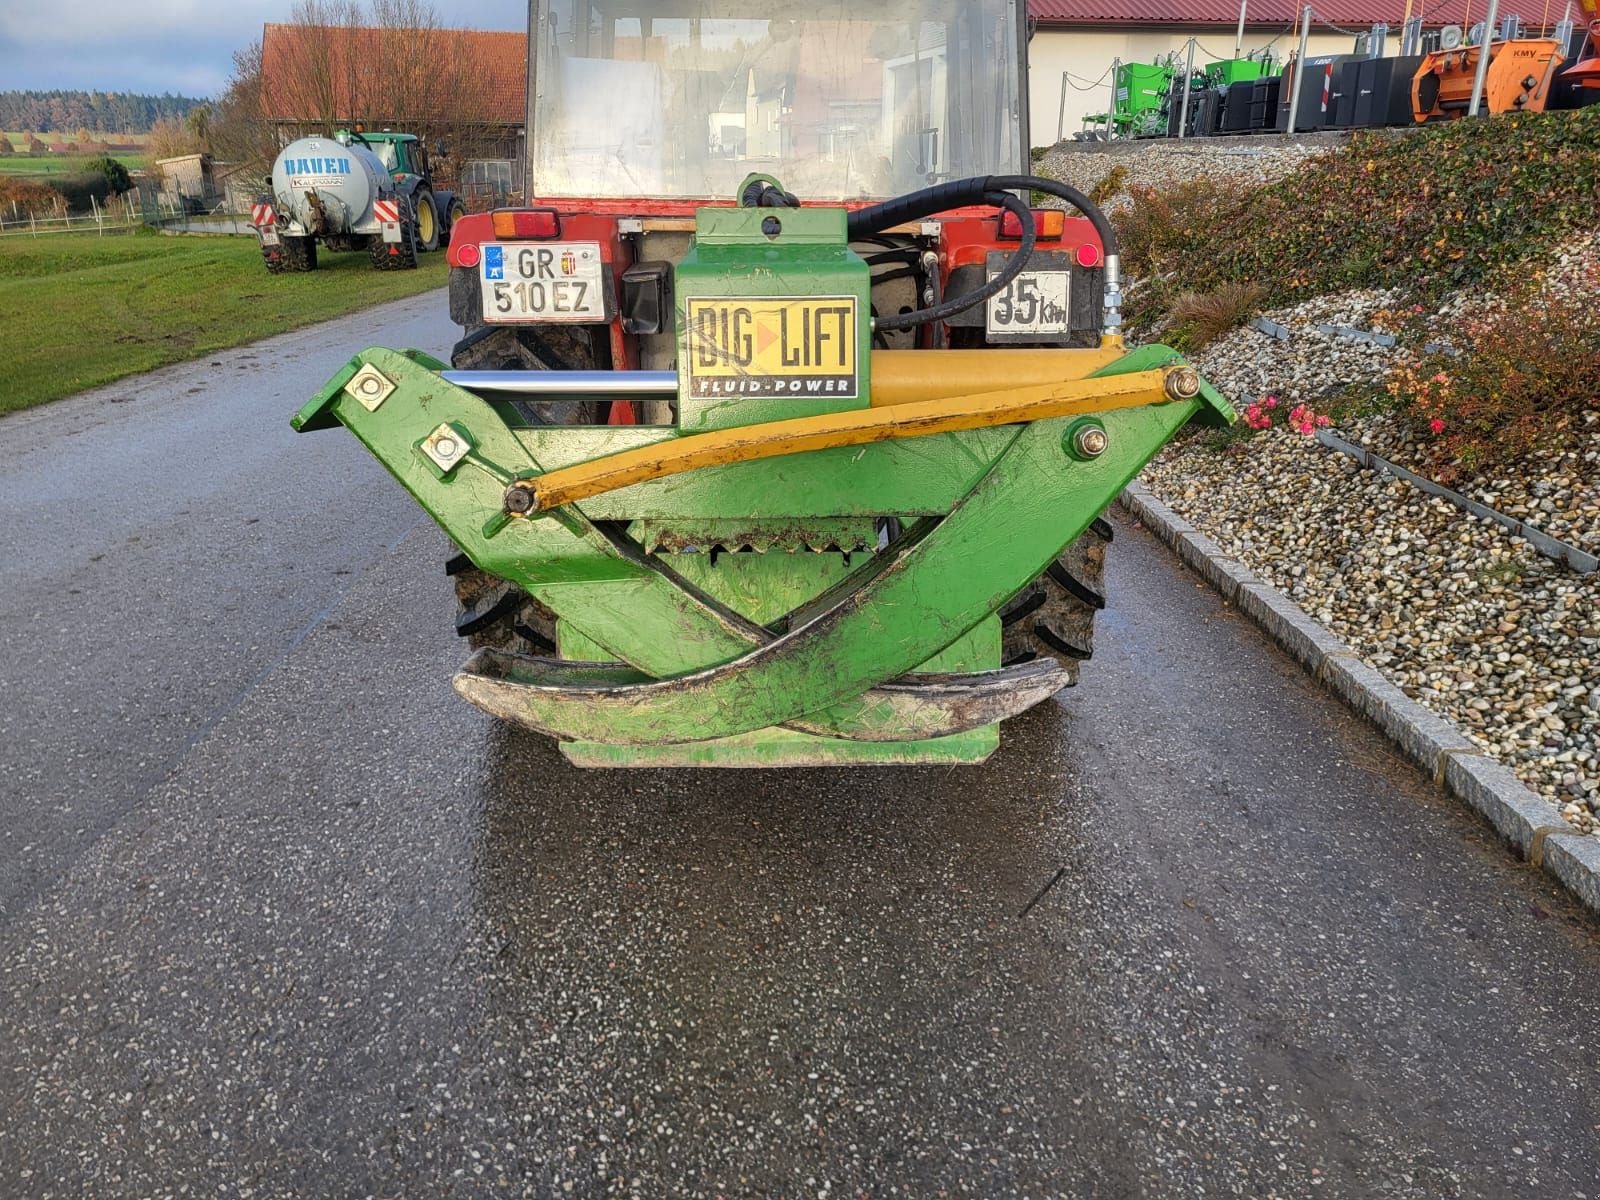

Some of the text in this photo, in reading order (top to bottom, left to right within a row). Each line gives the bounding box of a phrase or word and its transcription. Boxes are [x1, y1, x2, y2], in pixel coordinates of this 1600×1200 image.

[284, 158, 351, 175] BAUER
[490, 268, 499, 278] A
[518, 248, 555, 279] GR
[493, 281, 590, 313] 510 EZ
[697, 306, 851, 367] BIG LIFT
[700, 380, 849, 393] FLUID-POWER
